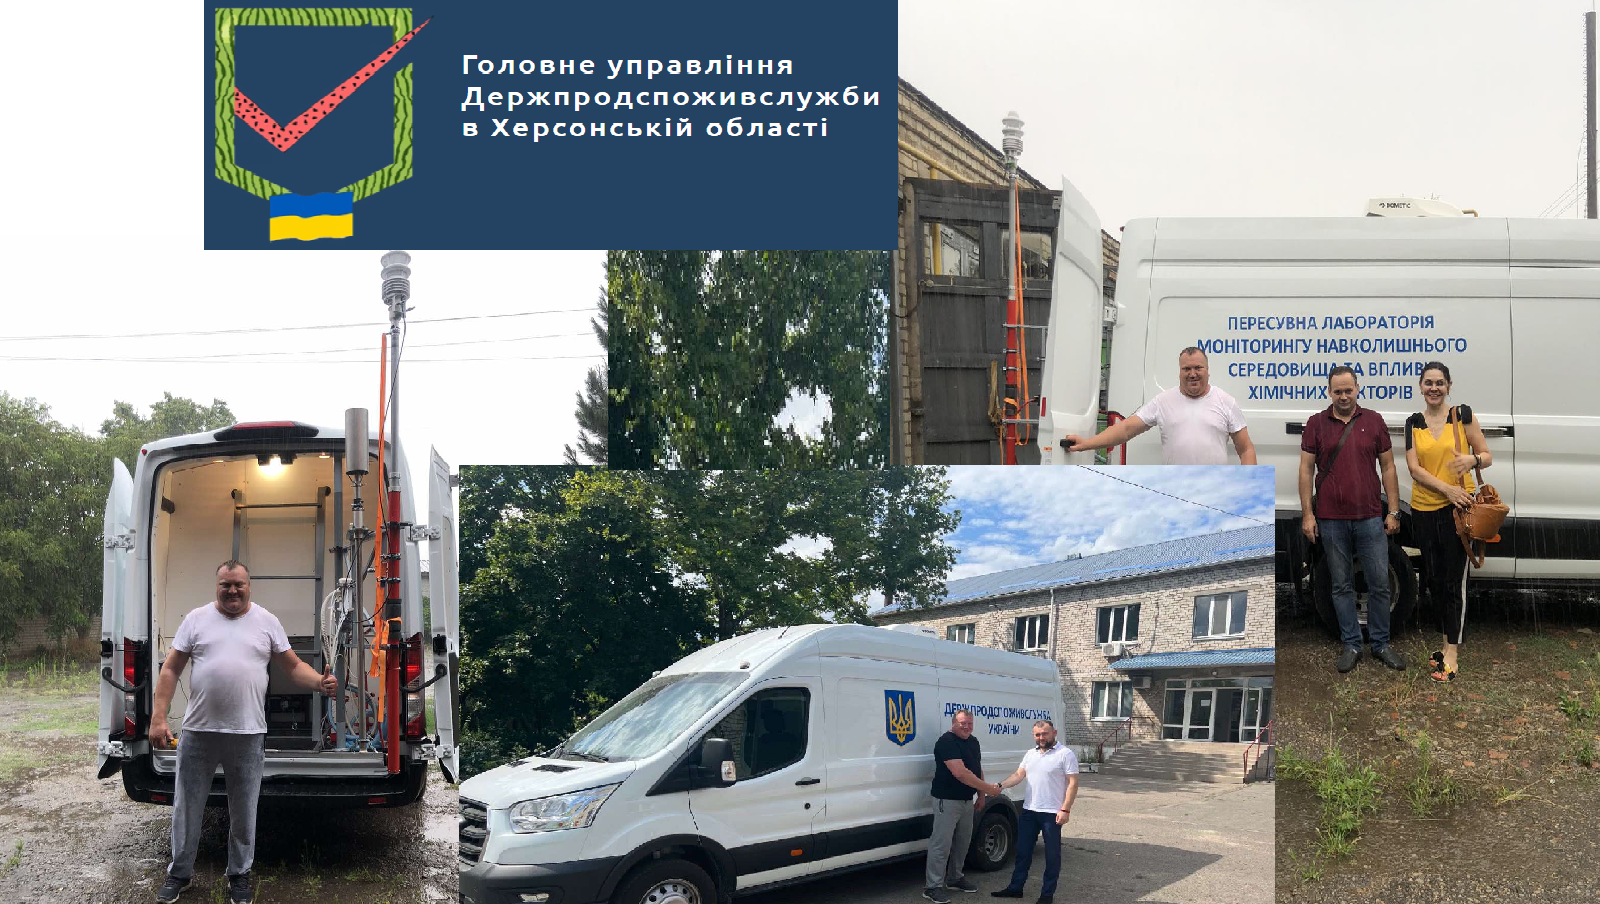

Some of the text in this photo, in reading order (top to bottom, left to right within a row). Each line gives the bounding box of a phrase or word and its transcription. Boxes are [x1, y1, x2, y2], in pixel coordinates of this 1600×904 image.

[1228, 315, 1434, 330] ПЕРЕСУВНА ЛАБОРАТОРІЯ
[1197, 337, 1468, 355] МОНІТОРИНГУ НАВКОЛИШНЬОГО
[1368, 361, 1429, 376] ВПЛИВ
[1248, 385, 1413, 400] ХІМІЧНИХ КТОРІВ
[988, 722, 1020, 735] УКРАЇНИ
